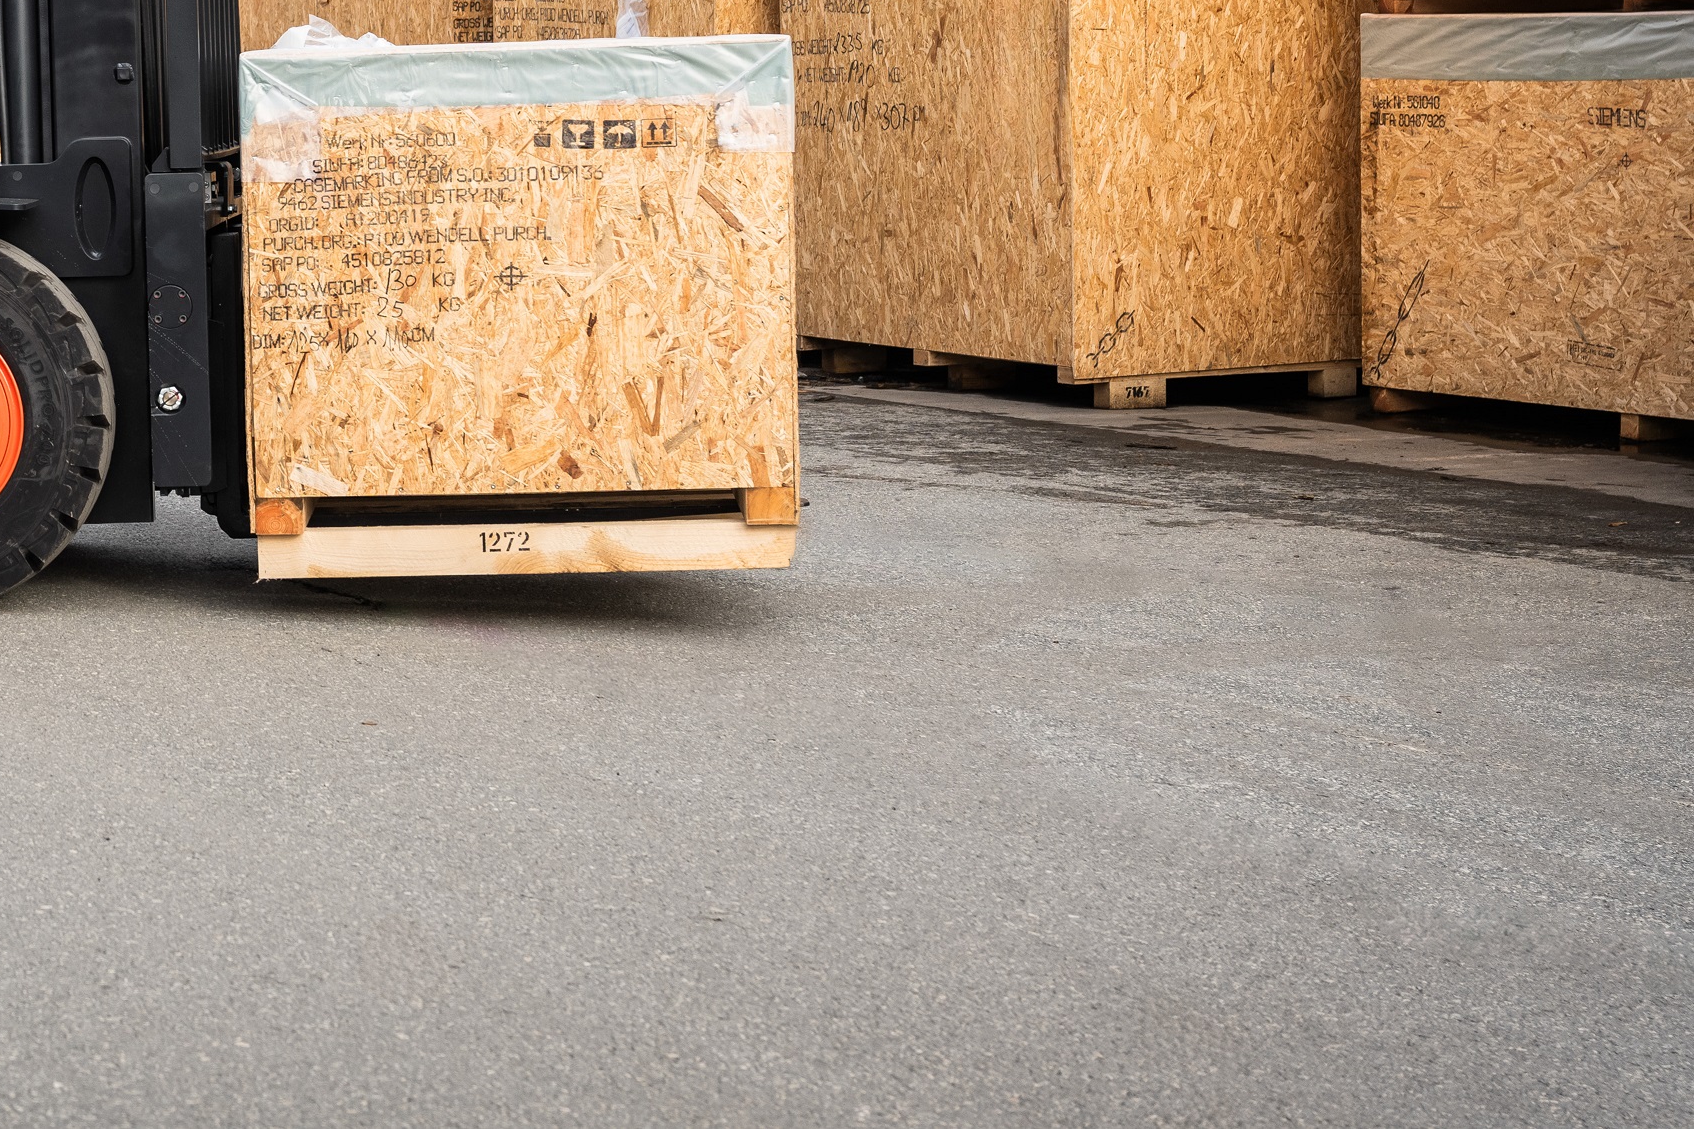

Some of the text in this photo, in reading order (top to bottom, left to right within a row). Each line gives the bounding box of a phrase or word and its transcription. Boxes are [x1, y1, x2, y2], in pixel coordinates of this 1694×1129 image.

[452, 1, 469, 11] SAP
[452, 17, 481, 29] GROSS
[557, 8, 586, 23] WENDELL
[472, 31, 493, 42] WEIG
[496, 26, 511, 39] SAP
[792, 41, 804, 56] OSS
[871, 39, 884, 57] KG
[888, 67, 901, 83] KG
[1372, 95, 1392, 109] Werk
[1406, 95, 1440, 109] 561040
[1398, 114, 1446, 128] 80487926
[1587, 106, 1646, 128] SIEMENS
[326, 134, 367, 149] Werk
[395, 132, 456, 148] 560600
[293, 171, 403, 193] CASEMARKING
[406, 168, 452, 184] FROM
[496, 165, 604, 182] 3010109136
[277, 196, 318, 211] 9462
[320, 191, 392, 211] SIEMENS
[394, 188, 479, 206] INDUSTRY
[268, 217, 319, 233] ORGID:
[364, 232, 405, 248] P100
[410, 226, 490, 245] WENDELL
[493, 225, 552, 241] PURCH.
[262, 257, 293, 272] SAP
[341, 249, 446, 268] 4510825812
[258, 268, 455, 298] GROSS WEIGHT: 130 KG
[262, 305, 293, 320] NET
[376, 297, 404, 318] 25
[438, 296, 461, 312] KG
[252, 333, 286, 350] DIM:
[410, 327, 435, 343] CM
[479, 531, 531, 553] 1272
